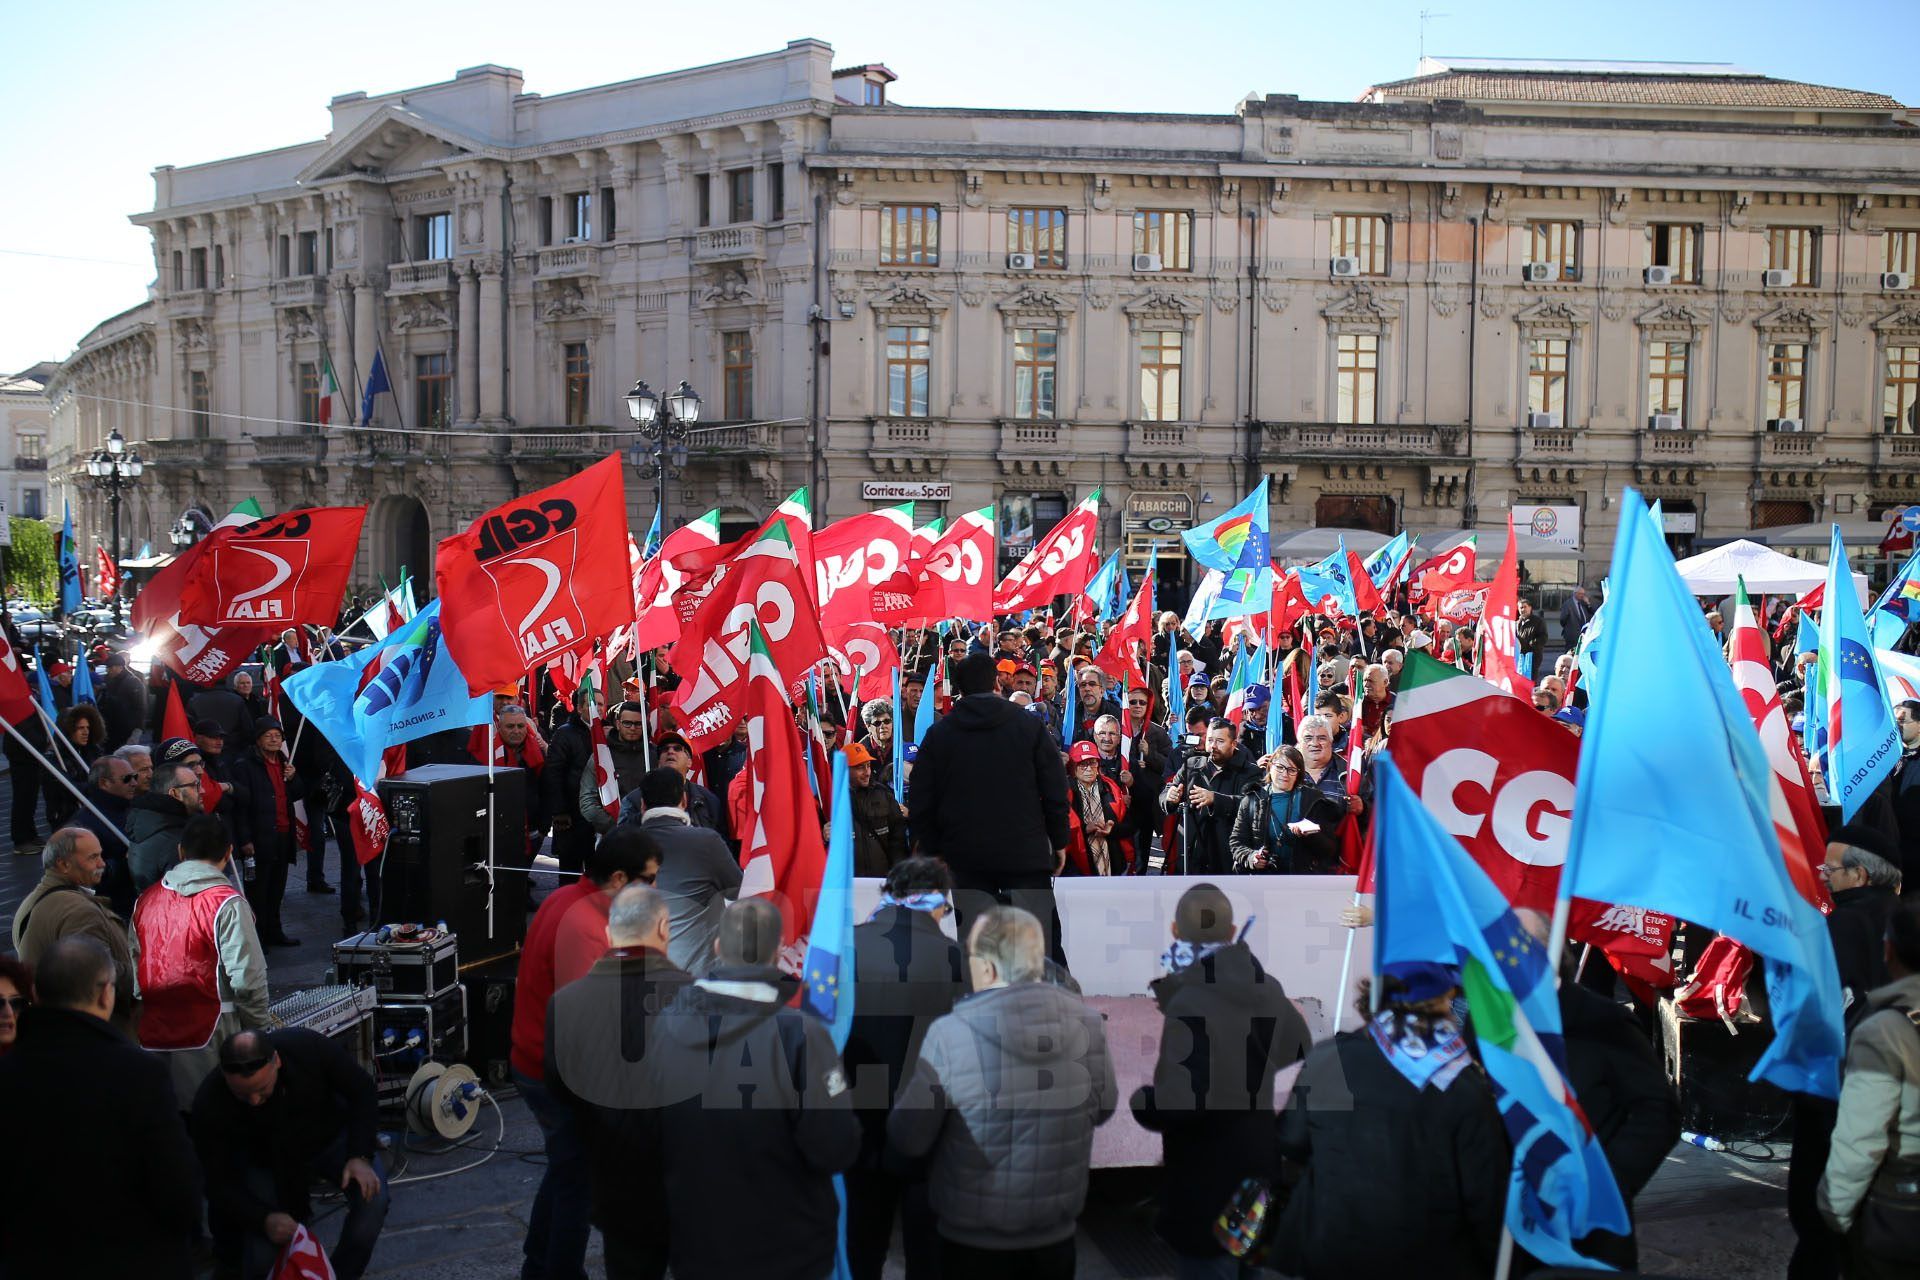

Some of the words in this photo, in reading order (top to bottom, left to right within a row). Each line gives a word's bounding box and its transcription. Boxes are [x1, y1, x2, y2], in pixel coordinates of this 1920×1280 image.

[864, 484, 905, 496] Corriere
[921, 485, 951, 498] Sport
[1133, 501, 1186, 512] TABACCHI
[1734, 898, 1755, 921] IL
[1645, 915, 1669, 926] ETUC
[1646, 926, 1661, 936] EGB
